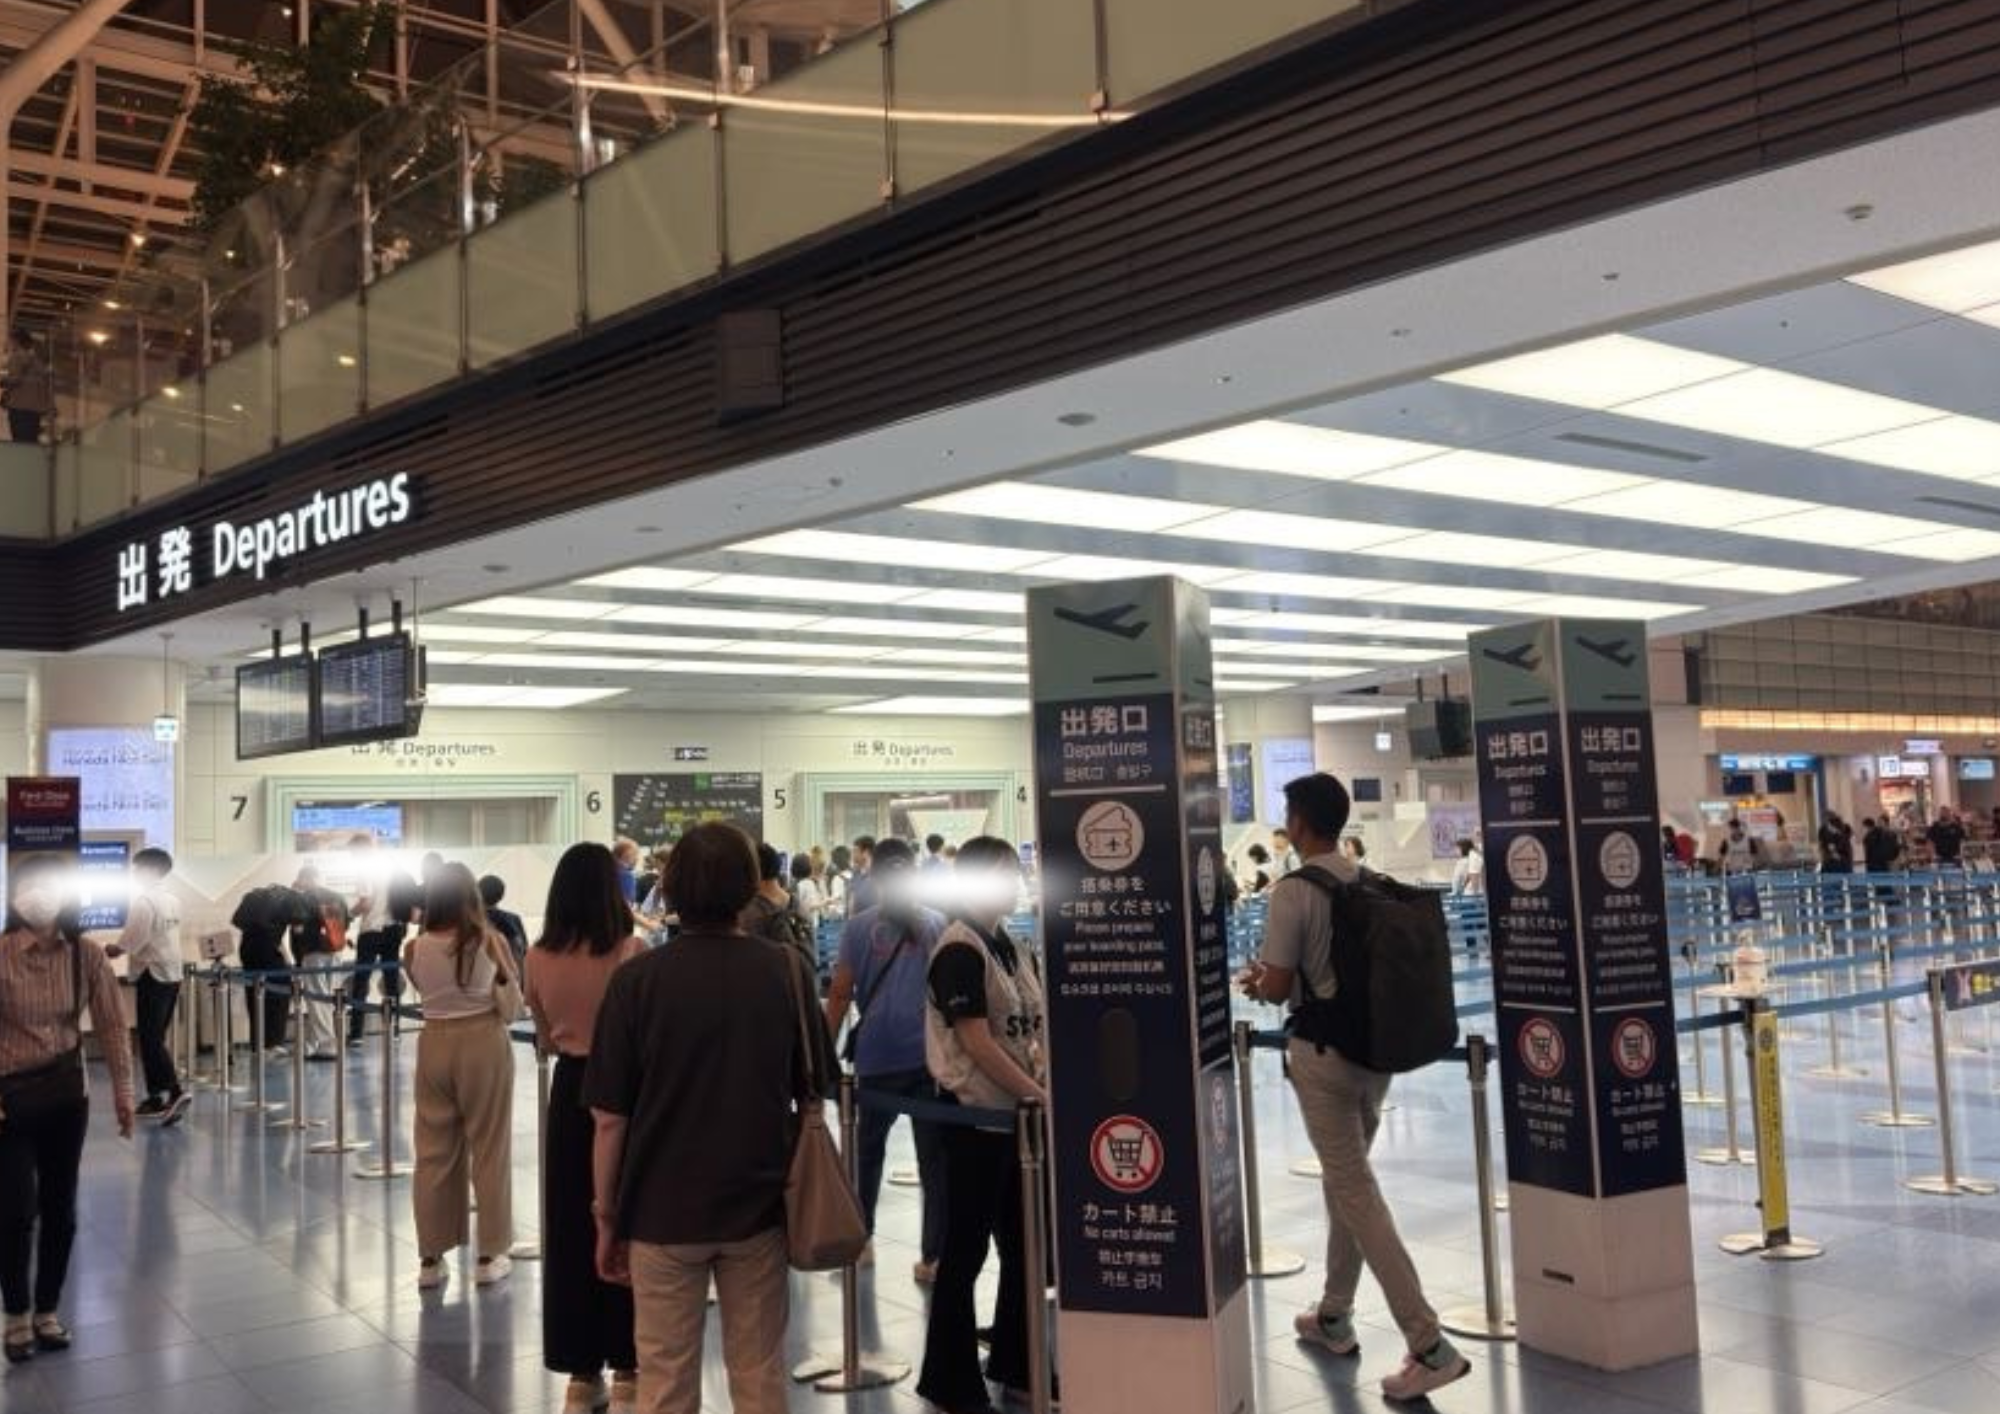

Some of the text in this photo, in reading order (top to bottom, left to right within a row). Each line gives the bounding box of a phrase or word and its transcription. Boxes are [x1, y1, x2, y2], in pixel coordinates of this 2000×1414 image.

[117, 472, 410, 612] 出発 Departures
[1062, 704, 1147, 737] 出発口
[403, 742, 496, 758] Departures
[1063, 741, 1148, 761] Departures
[1488, 731, 1548, 760] 出発口
[1581, 726, 1640, 754] 出発口
[586, 791, 601, 814] 6
[774, 789, 786, 810] 5
[1016, 785, 1028, 803] 4
[231, 795, 248, 821] 7
[1083, 1202, 1178, 1224] カート禁止
